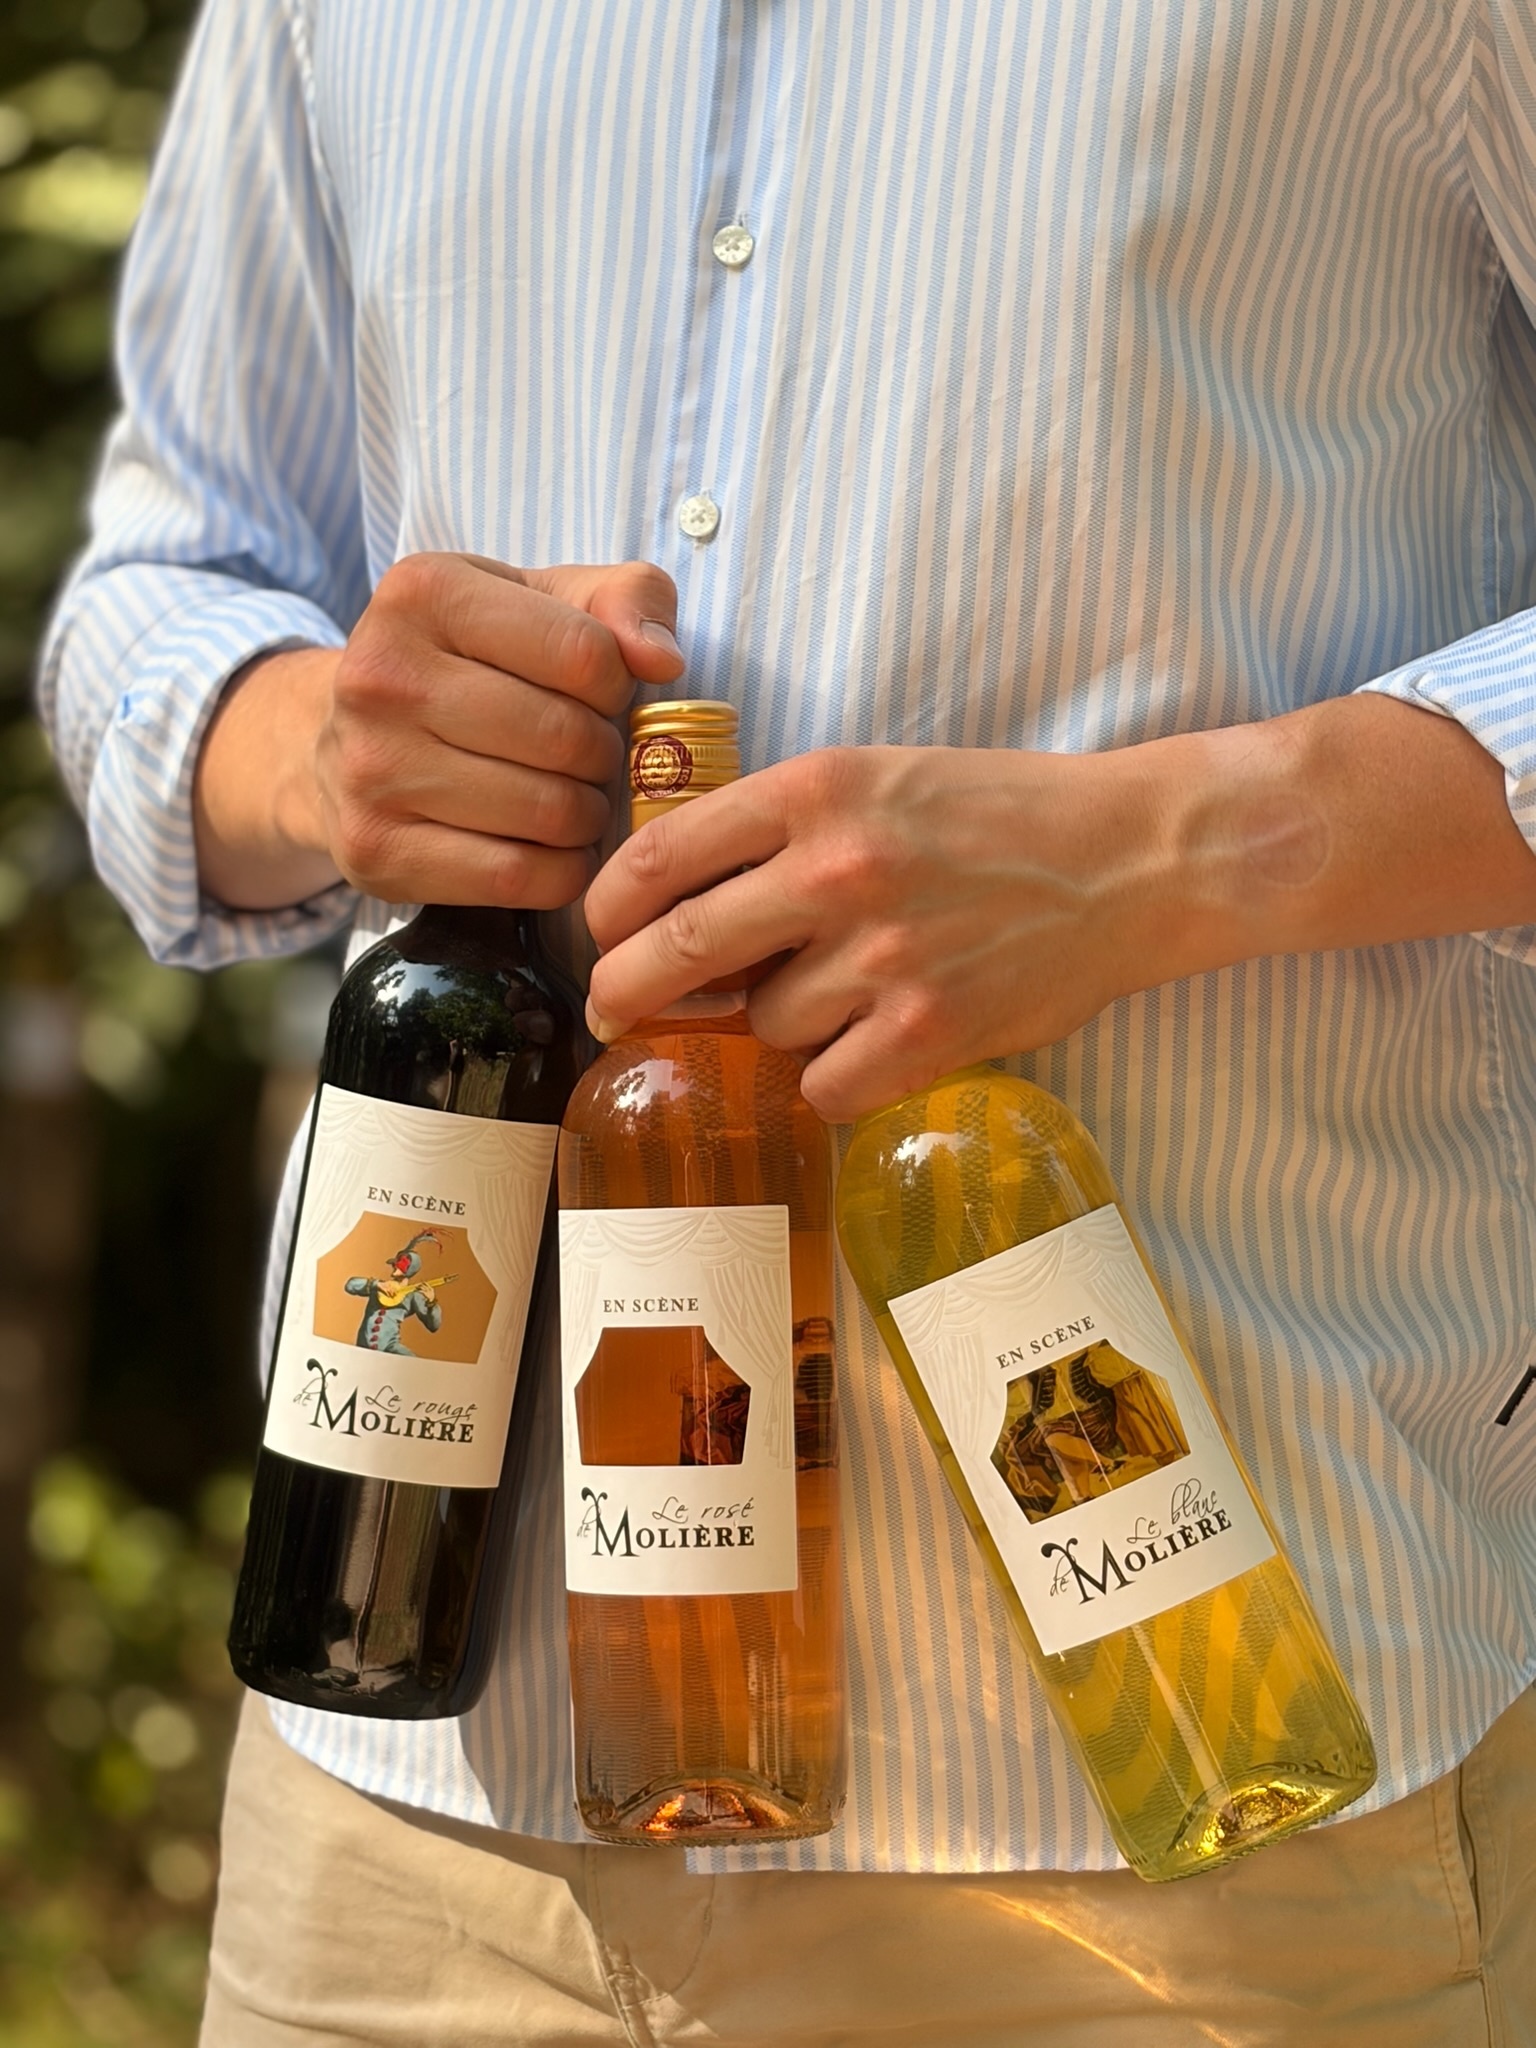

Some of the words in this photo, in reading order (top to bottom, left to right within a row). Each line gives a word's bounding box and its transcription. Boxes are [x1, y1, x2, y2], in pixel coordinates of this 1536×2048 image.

[367, 1186, 392, 1203] EN
[399, 1193, 466, 1215] SCÈNE
[603, 1299, 625, 1313] EN
[632, 1296, 699, 1313] SCÈNE
[996, 1347, 1024, 1369] EN
[1030, 1316, 1095, 1354] SCÈNE
[293, 1377, 328, 1406] de
[306, 1358, 475, 1443] MOLIÈRE
[364, 1385, 402, 1413] Le
[412, 1400, 478, 1424] rouge
[576, 1505, 602, 1538] de
[581, 1487, 755, 1557] MOLIÈRE
[652, 1496, 689, 1524] Le
[701, 1497, 755, 1519] rosé
[1126, 1517, 1162, 1544] Le
[1170, 1478, 1218, 1525] blanc
[1041, 1508, 1232, 1605] MOLIÈRE
[1050, 1554, 1076, 1597] de
